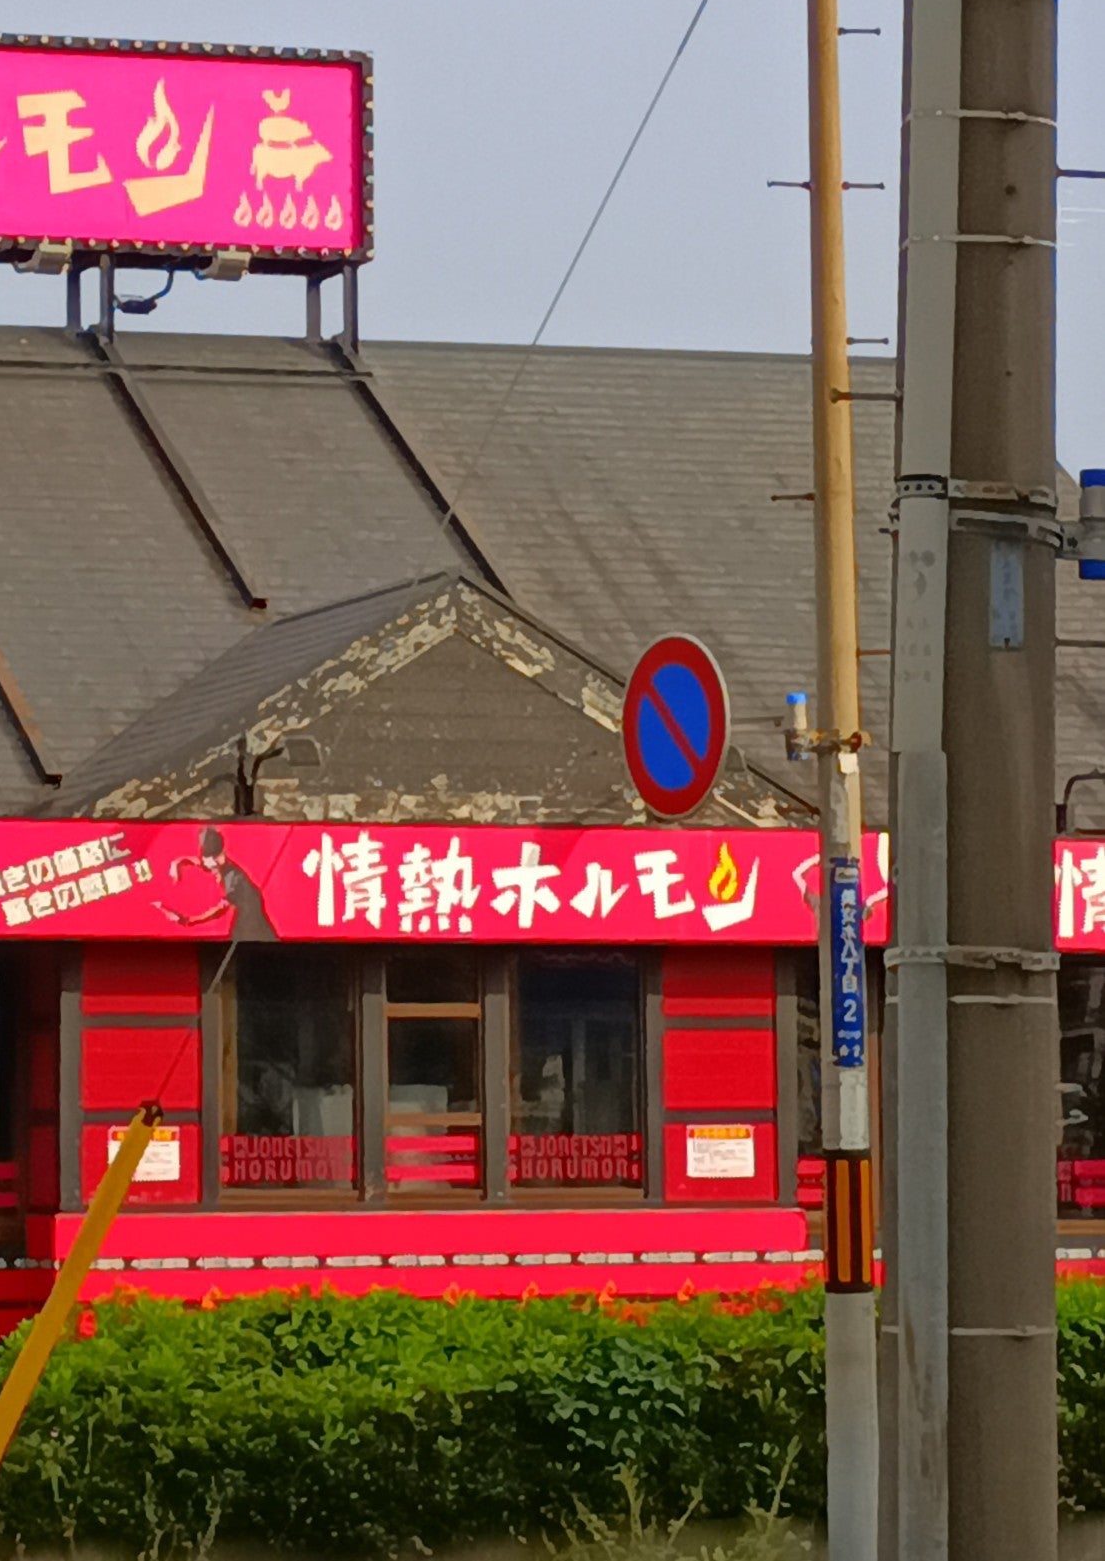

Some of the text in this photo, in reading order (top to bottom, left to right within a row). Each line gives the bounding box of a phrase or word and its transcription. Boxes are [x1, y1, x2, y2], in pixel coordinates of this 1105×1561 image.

[302, 831, 760, 934] 情熱ホルモン
[843, 999, 857, 1022] 2
